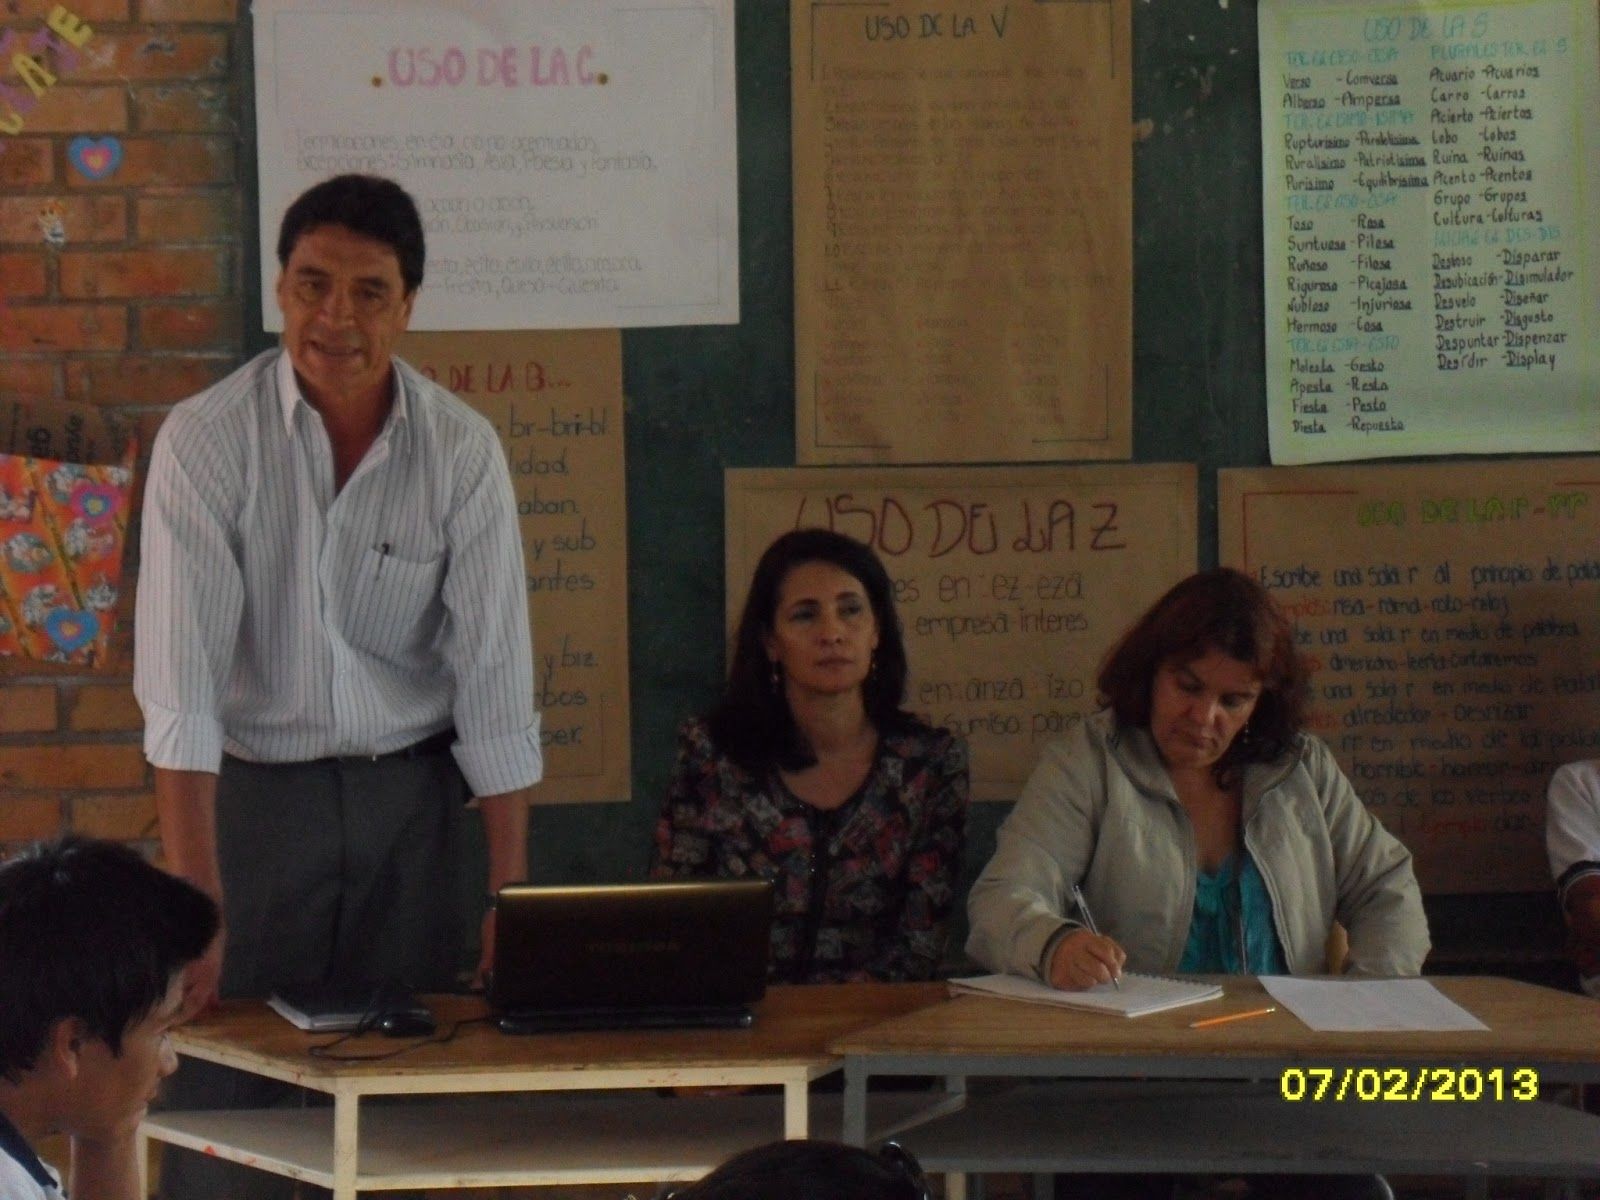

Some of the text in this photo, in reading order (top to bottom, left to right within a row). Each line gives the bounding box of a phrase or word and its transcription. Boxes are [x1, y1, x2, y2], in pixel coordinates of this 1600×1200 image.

[865, 5, 1008, 41] USO DE LA V
[1471, 12, 1489, 38] S
[387, 45, 466, 87] USO
[477, 46, 519, 88] DE
[530, 44, 569, 87] LA
[1430, 86, 1469, 103] Carro
[1432, 128, 1458, 145] Lobo
[1434, 189, 1471, 211] Grupo
[1433, 209, 1484, 227] Cultura
[1434, 313, 1486, 331] Destruir
[1435, 332, 1500, 354] Despuntar
[553, 518, 597, 551] sub
[1090, 503, 1126, 550] Z
[939, 575, 971, 603] en
[916, 612, 1008, 643] empresa
